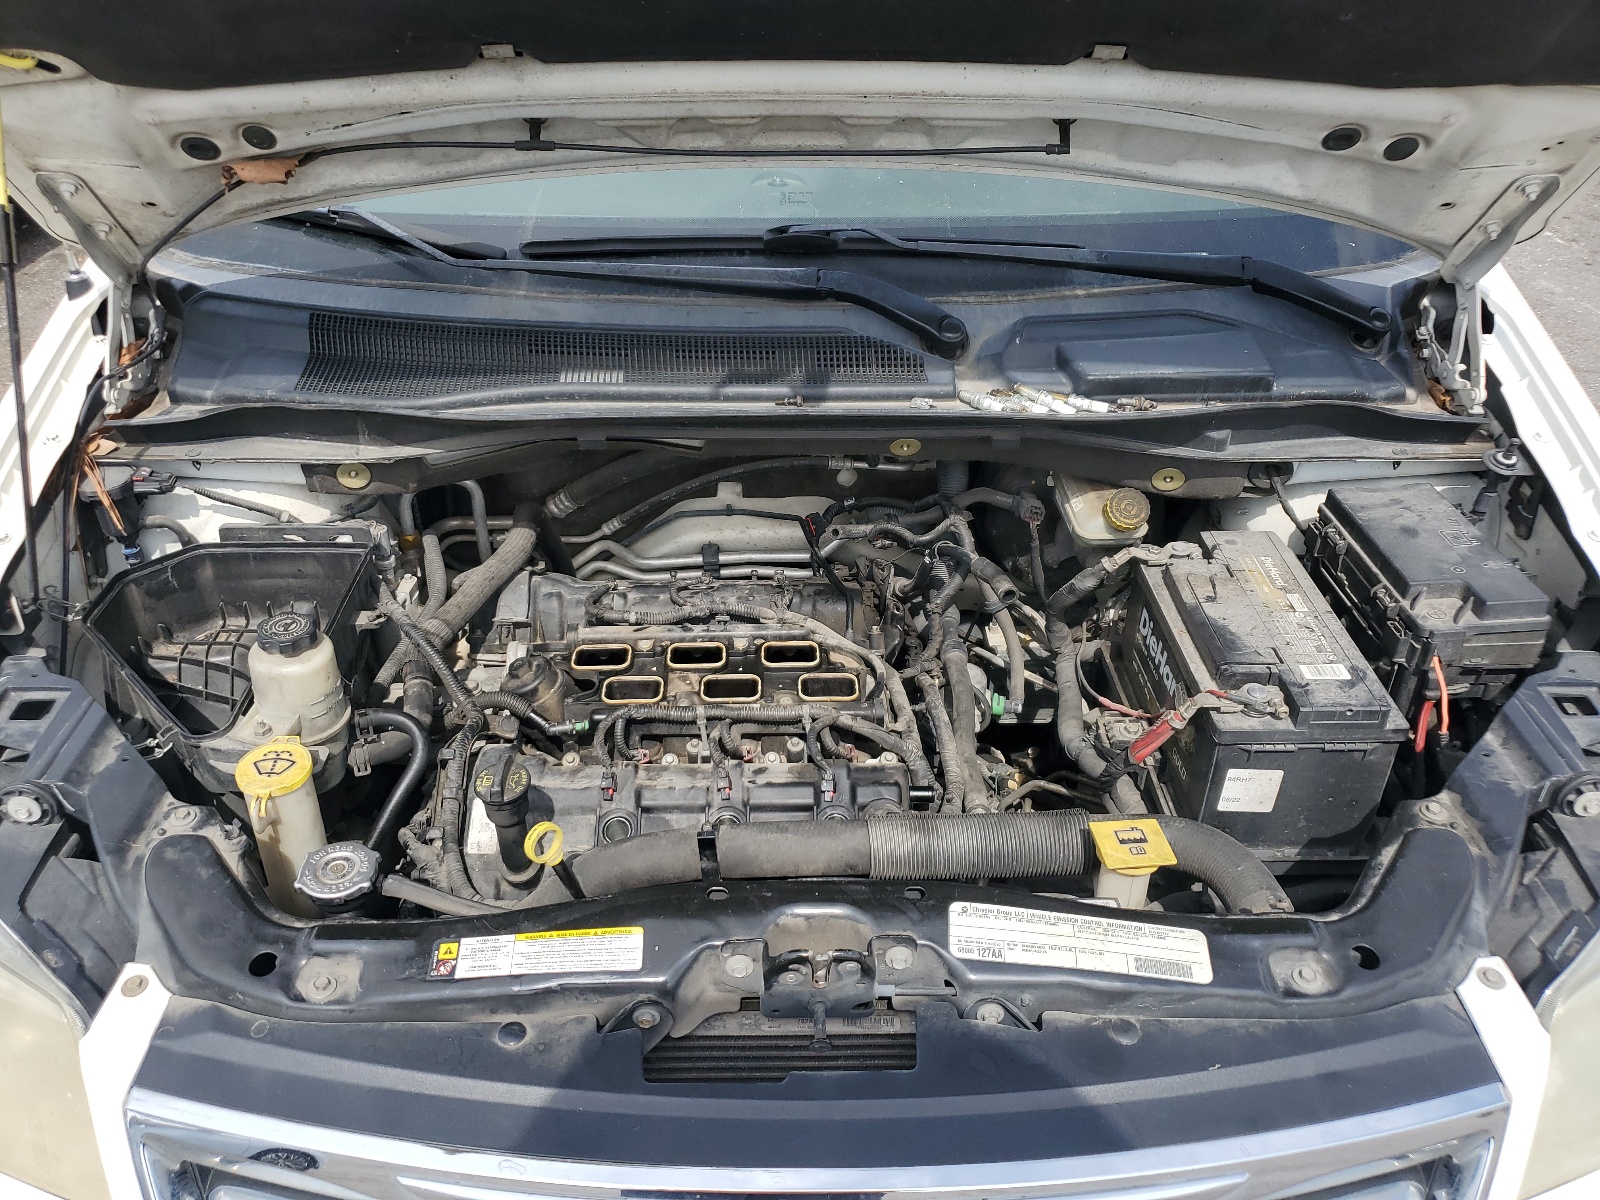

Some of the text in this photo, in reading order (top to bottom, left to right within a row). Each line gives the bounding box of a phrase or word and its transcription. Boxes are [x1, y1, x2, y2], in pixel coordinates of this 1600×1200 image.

[1260, 556, 1288, 587] DieHard
[1139, 606, 1178, 698] DieHar
[972, 906, 995, 915] Chrysler
[996, 908, 1012, 917] Group
[1014, 910, 1025, 918] LLC
[1053, 915, 1079, 924] EMISSION
[1080, 918, 1105, 927] CONTROL
[1106, 921, 1143, 932] INFORMATION
[976, 947, 1003, 959] 127AA
